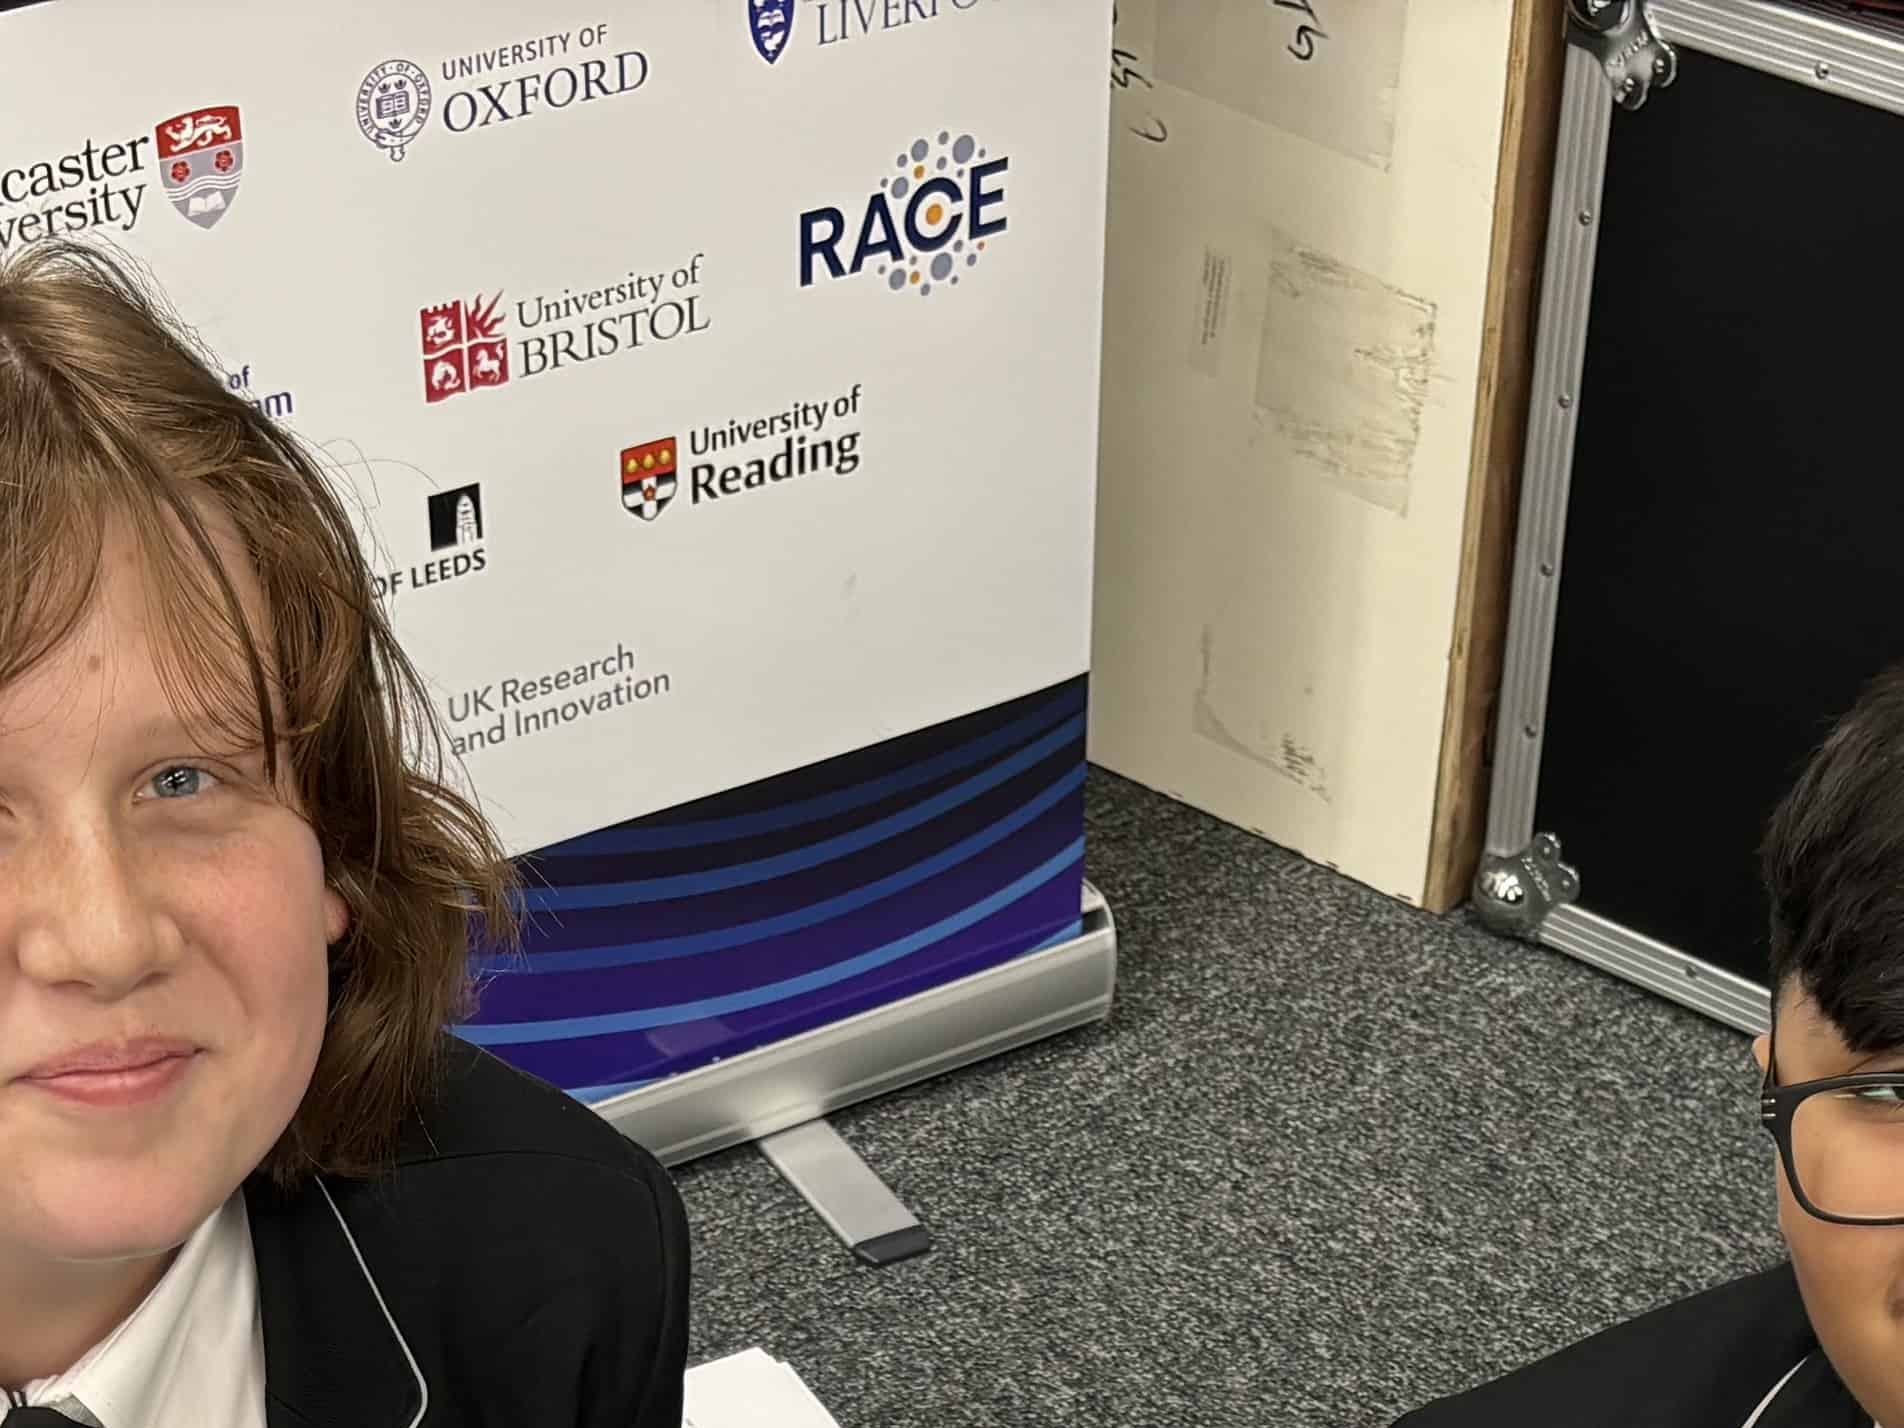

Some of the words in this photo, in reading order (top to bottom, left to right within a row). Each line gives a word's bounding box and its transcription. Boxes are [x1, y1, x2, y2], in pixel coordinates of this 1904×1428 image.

[441, 31, 571, 81] UNIVERSITY
[579, 23, 608, 48] OF
[816, 0, 978, 45] LIVER
[442, 50, 648, 133] OXFORD
[800, 156, 1008, 288] RACE
[516, 271, 664, 330] University
[671, 253, 705, 289] of
[517, 295, 712, 380] BRISTOL
[229, 365, 251, 390] of
[690, 400, 830, 456] University
[833, 383, 862, 417] of
[690, 431, 861, 505] Reading
[410, 548, 487, 590] LEEDS
[447, 685, 495, 723] UK
[501, 642, 635, 708] Research
[451, 712, 506, 757] and
[514, 672, 671, 738] Innovation
